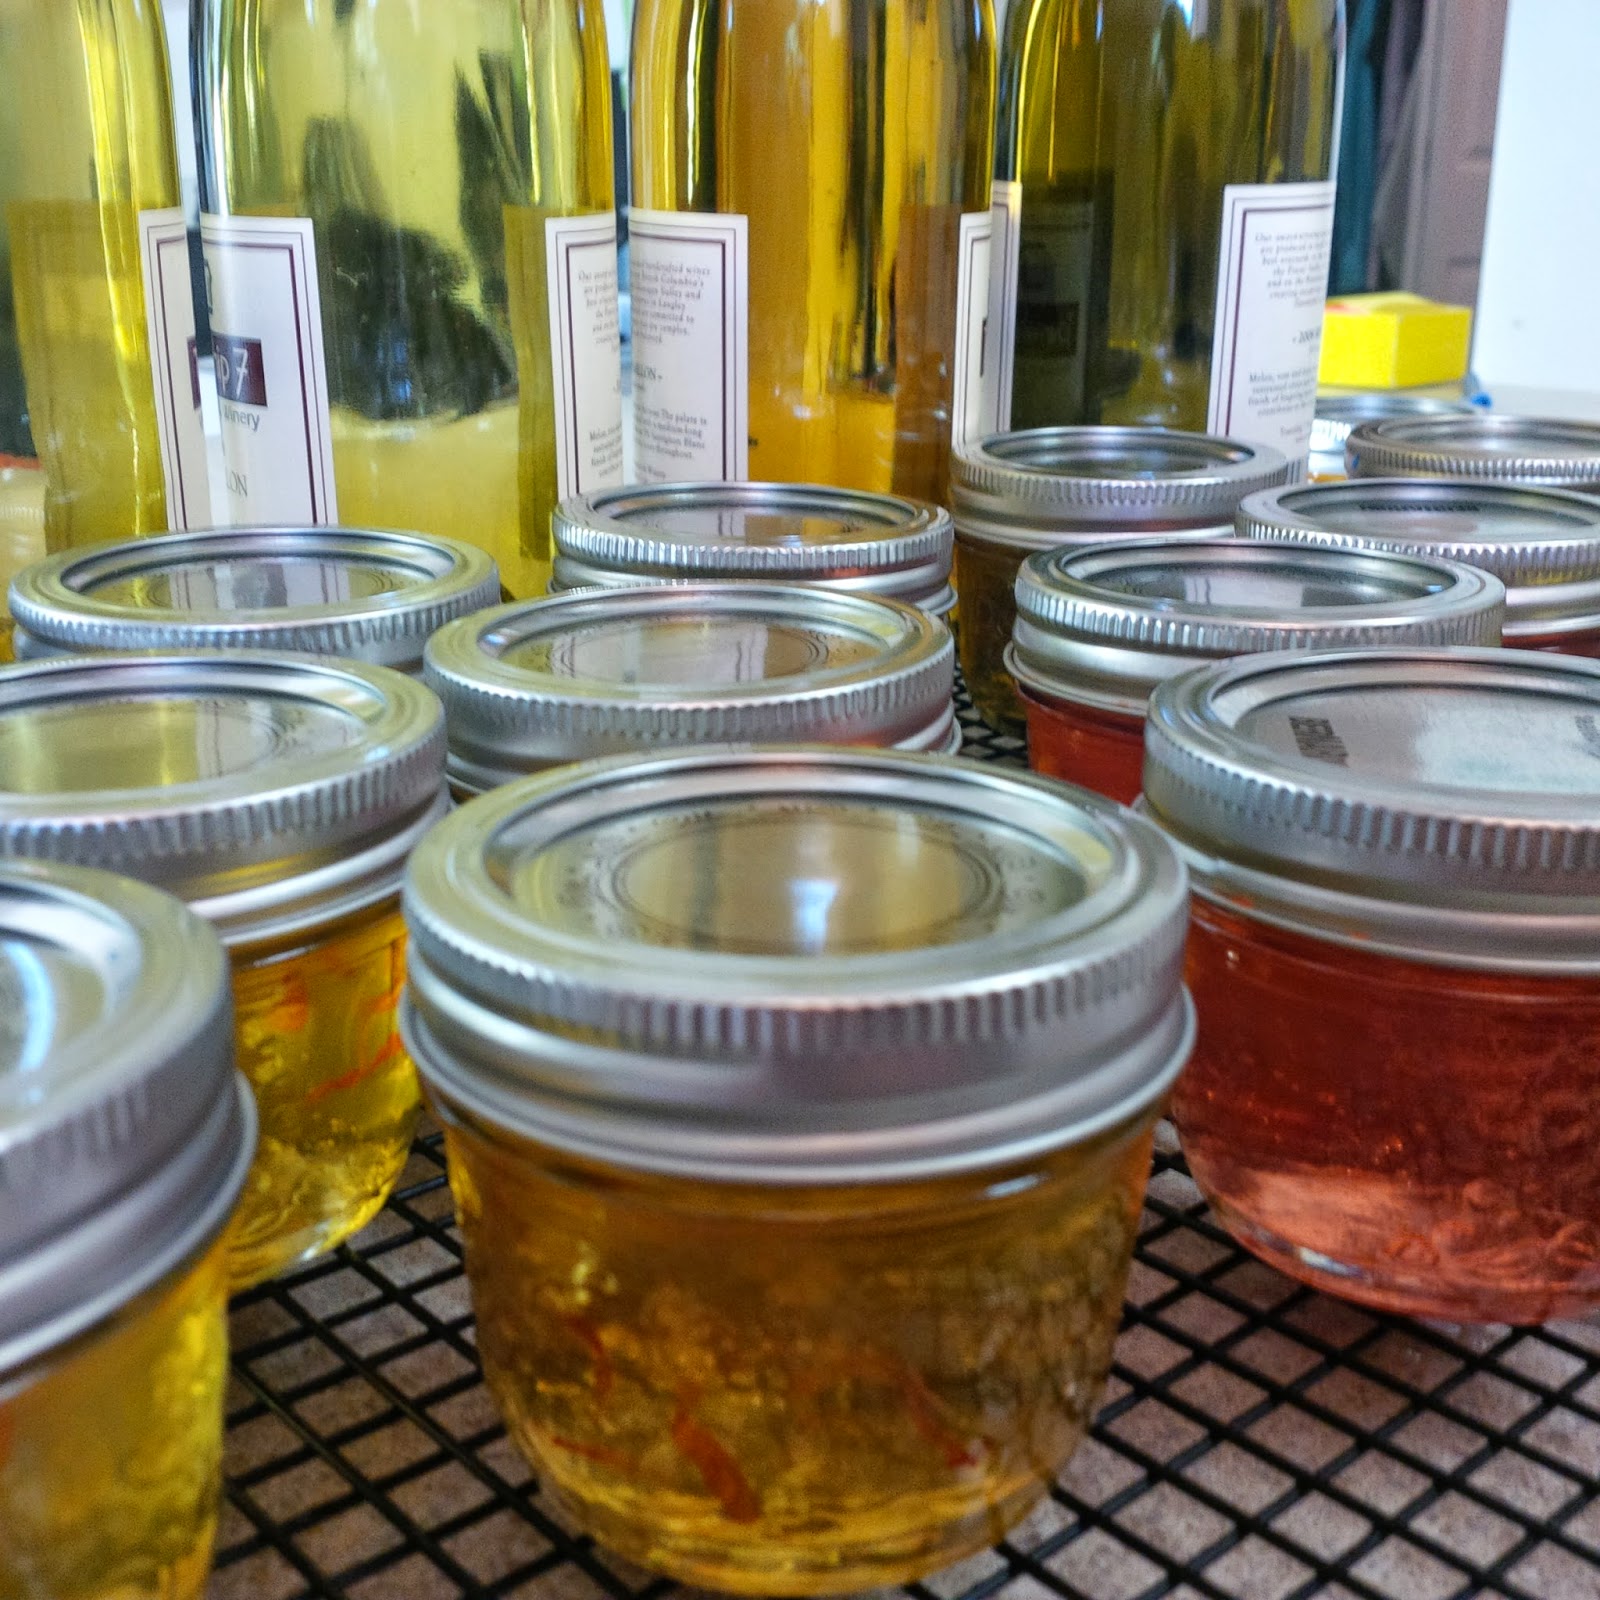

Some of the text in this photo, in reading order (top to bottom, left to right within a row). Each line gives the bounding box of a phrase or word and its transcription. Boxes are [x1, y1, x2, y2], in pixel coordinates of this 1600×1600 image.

[685, 288, 702, 301] and
[231, 346, 249, 401] 7
[683, 436, 706, 450] Blanc
